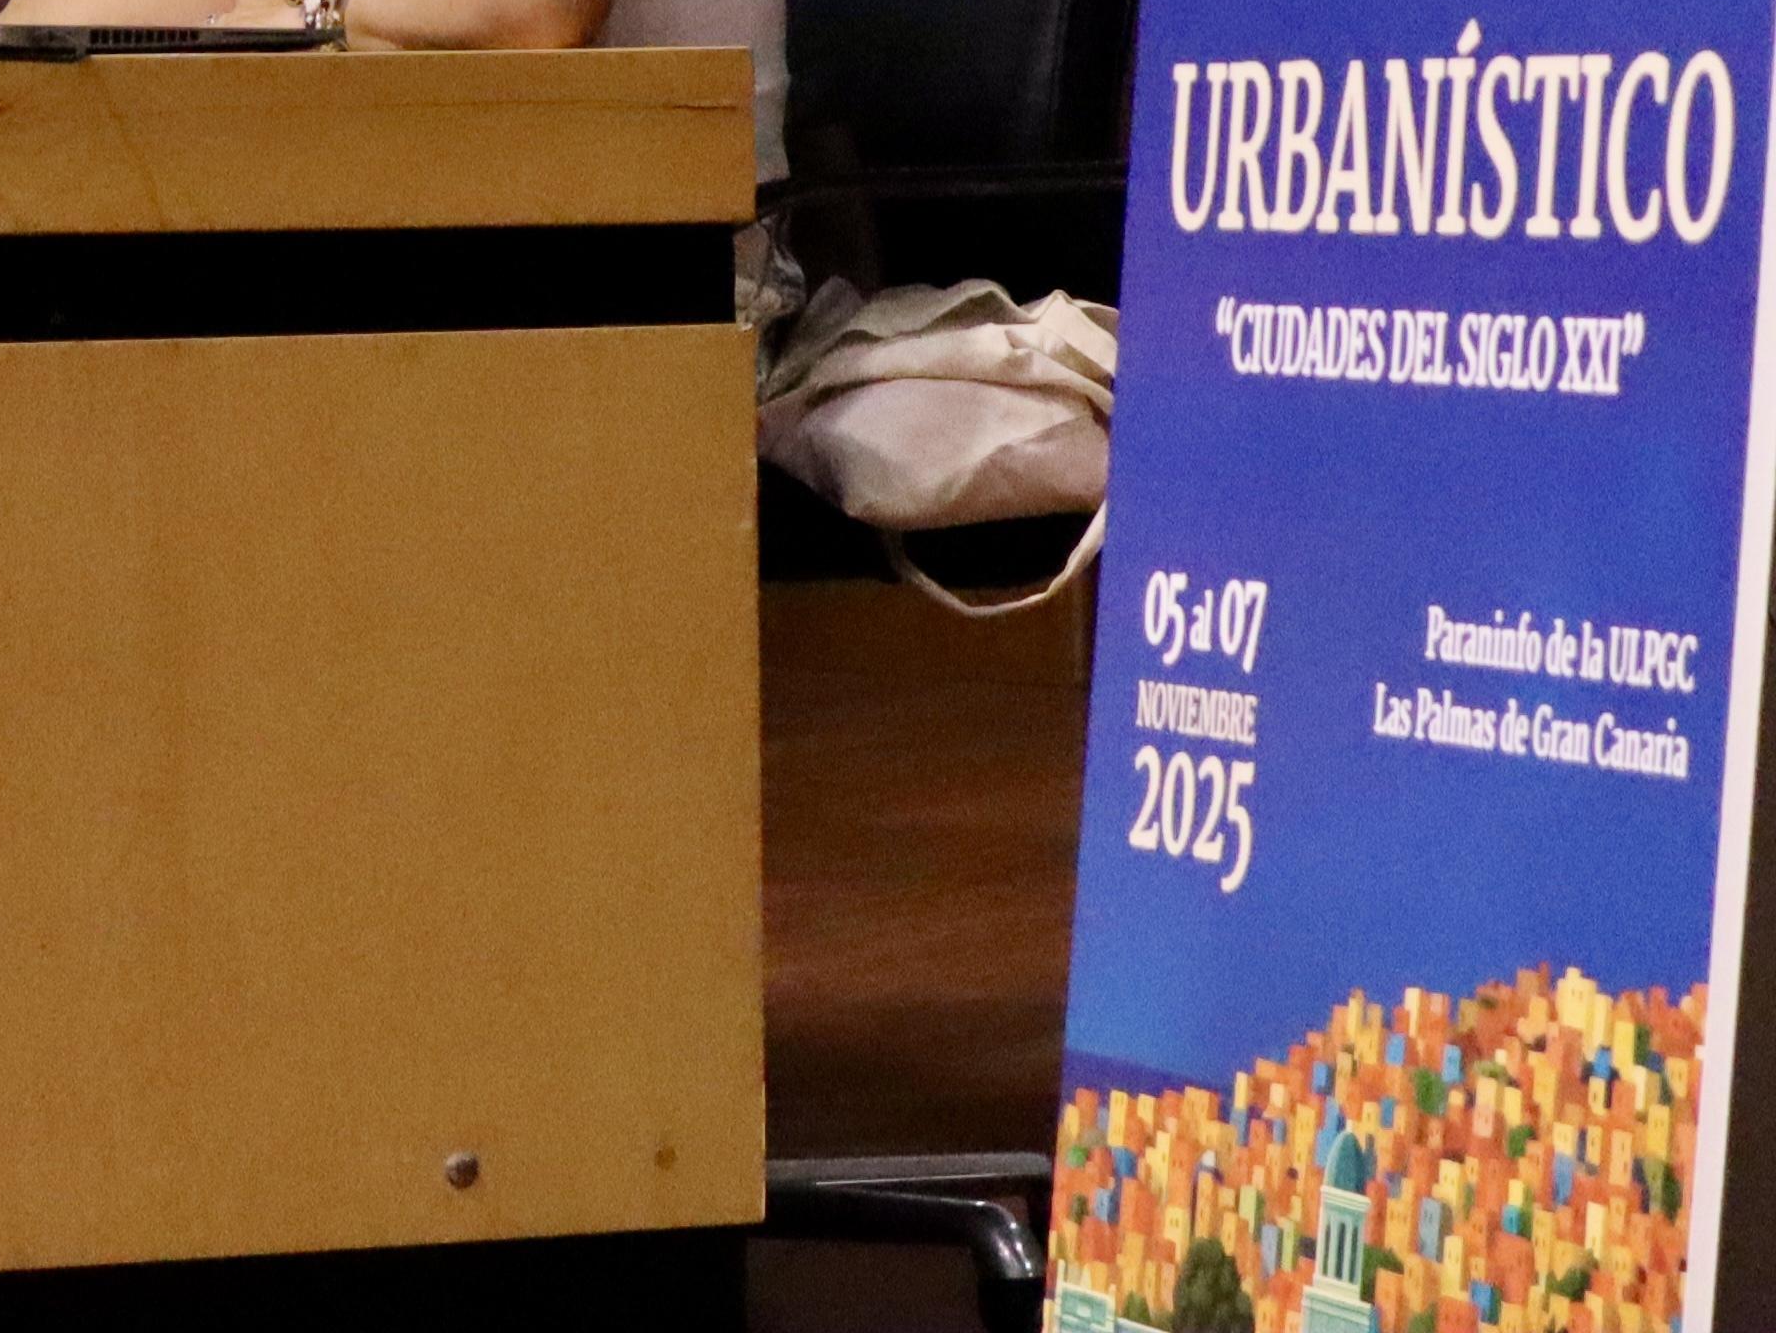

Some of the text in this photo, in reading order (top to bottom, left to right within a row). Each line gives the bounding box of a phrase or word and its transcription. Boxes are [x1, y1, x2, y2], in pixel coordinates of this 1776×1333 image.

[1170, 17, 1737, 243] URBANÍSTICO
[1389, 309, 1453, 385] DEL
[1457, 312, 1557, 391] SIGLO
[1144, 570, 1267, 673] 05 al 07
[1424, 604, 1698, 694] Paraninfo de la ULPGC
[1136, 679, 1258, 748] NOVIEMBRE
[1373, 682, 1689, 779] Las Palmas de Gran Canaria
[1129, 745, 1254, 893] 2025
